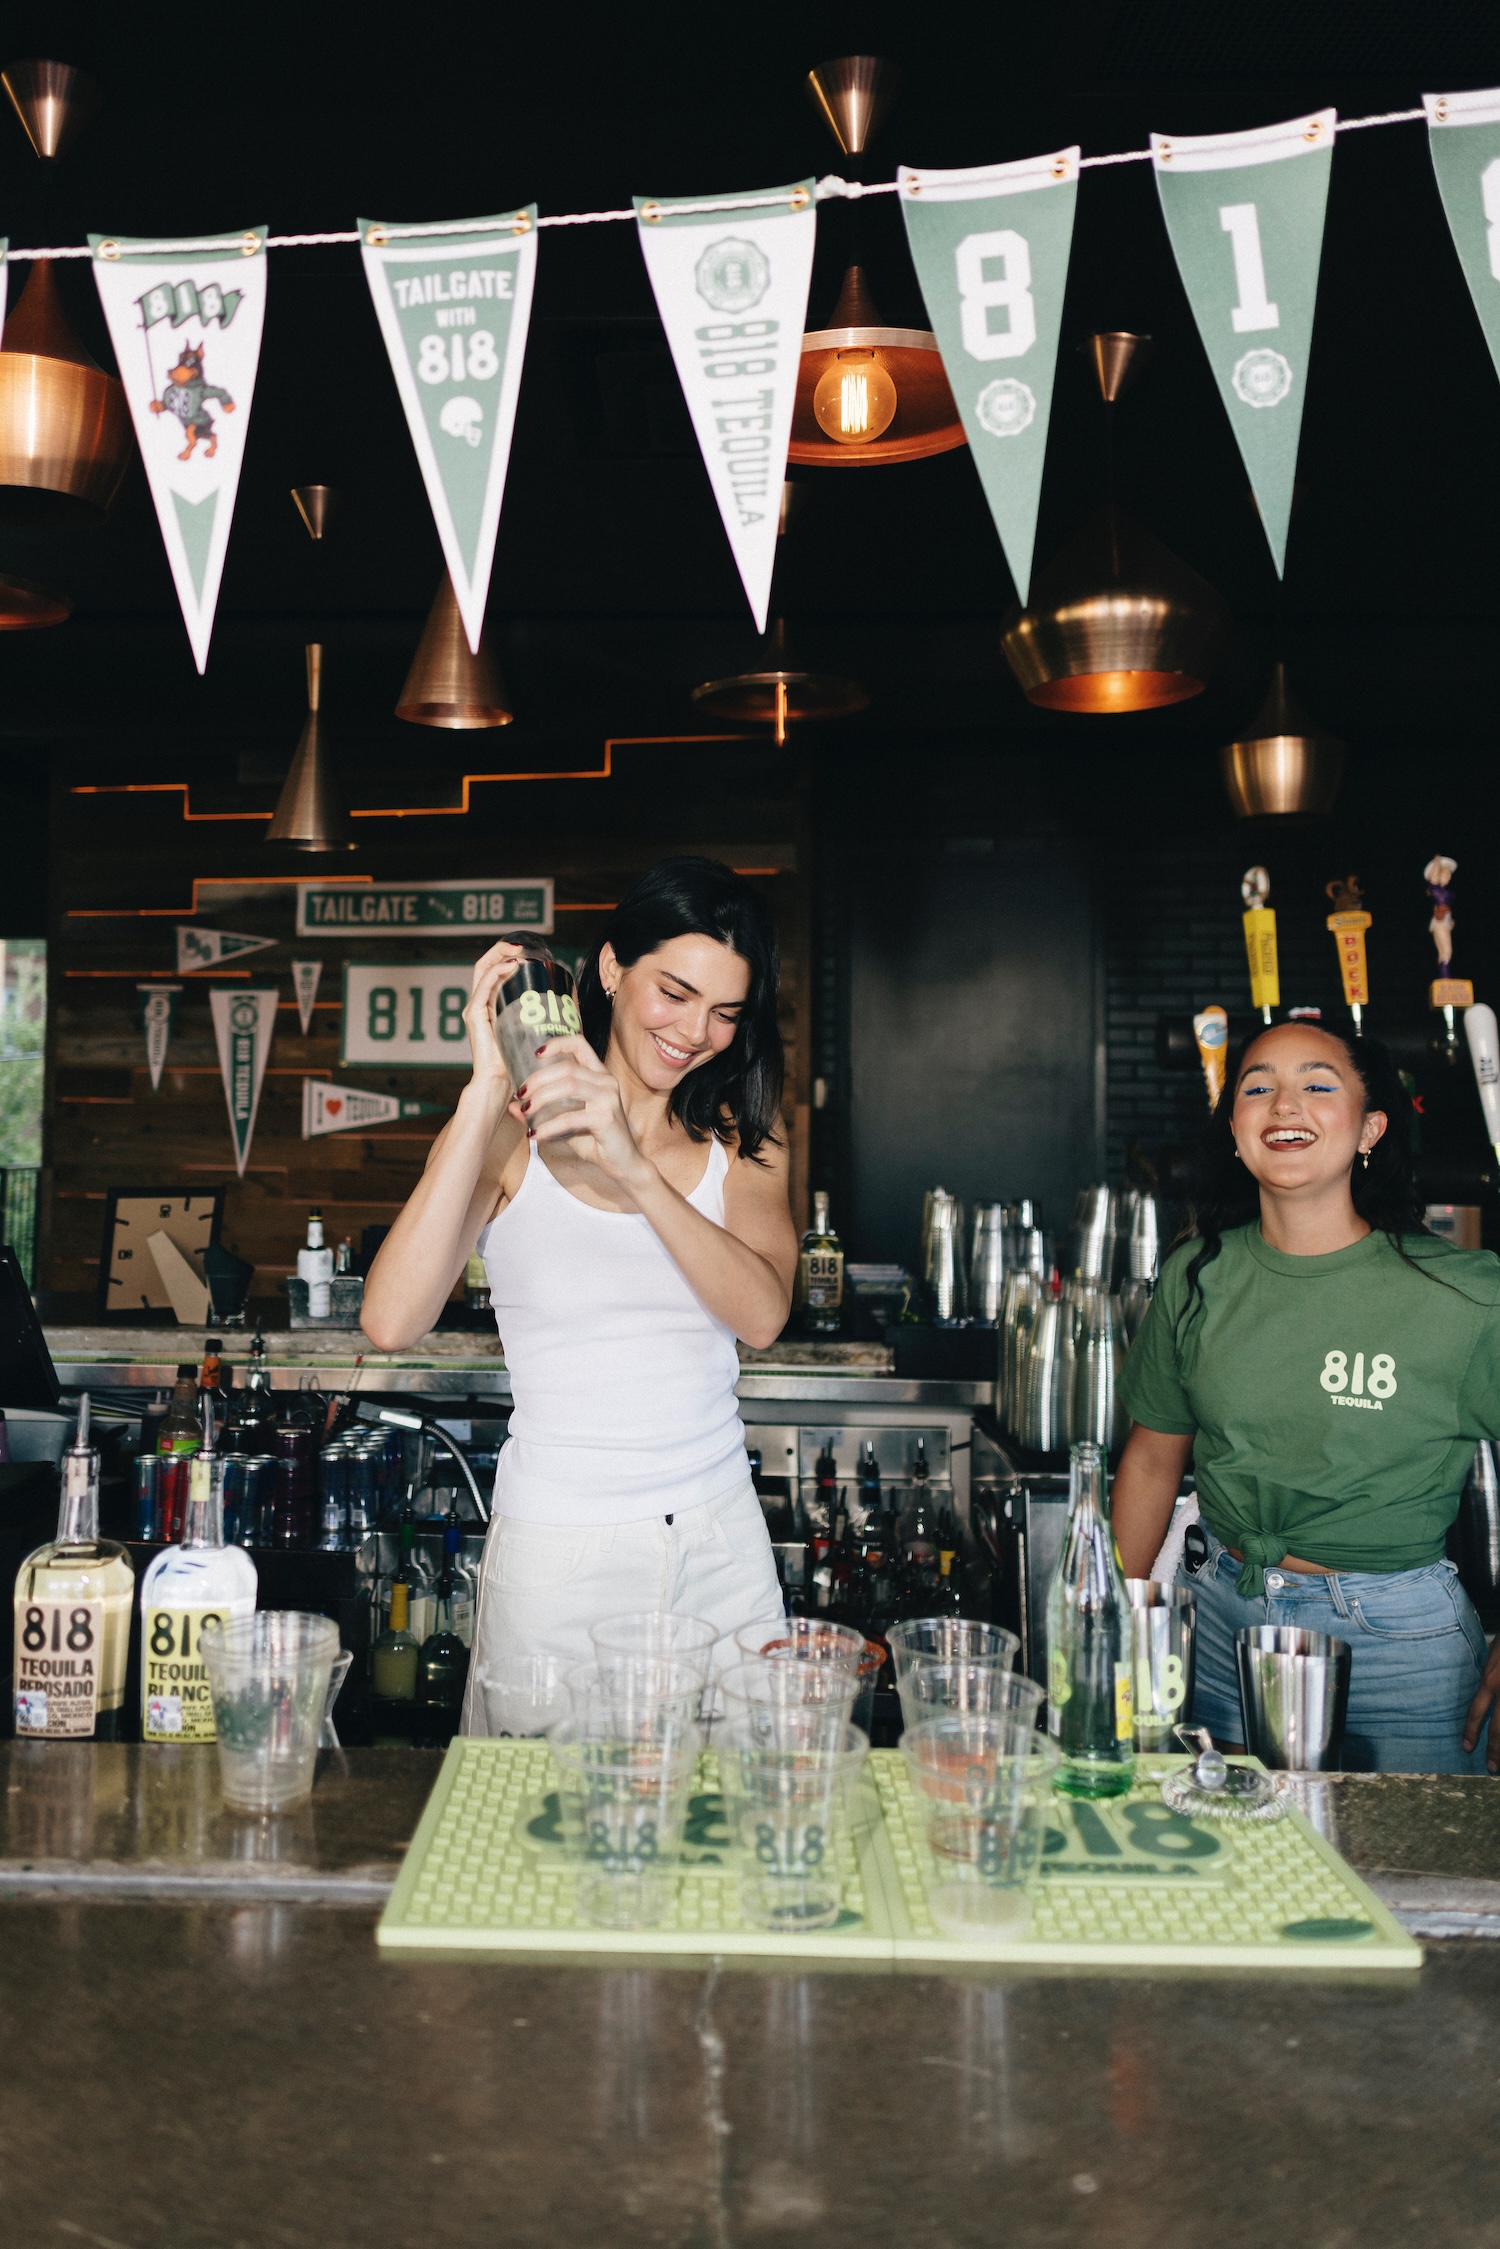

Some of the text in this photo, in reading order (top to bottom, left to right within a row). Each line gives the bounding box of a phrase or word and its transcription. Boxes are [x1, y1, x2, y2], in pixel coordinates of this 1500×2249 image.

[1218, 203, 1280, 333] 1
[148, 282, 223, 320] 818
[394, 269, 513, 309] TAILGATE
[955, 229, 1037, 362] 8
[435, 306, 477, 328] WITH
[417, 329, 500, 385] 818
[694, 319, 780, 528] 818 TEQUILA
[312, 895, 418, 923] TAILGATE
[462, 894, 505, 921] 818
[368, 986, 467, 1042] 818
[519, 989, 581, 1031] 818
[346, 1094, 391, 1122] TEQUILA
[809, 1258, 838, 1275] 818
[1319, 1349, 1398, 1399] 818
[1330, 1394, 1384, 1411] TEQUILA
[22, 1606, 94, 1653] 818
[19, 1657, 94, 1678] TEQUILA
[149, 1662, 209, 1682] TEQUIL
[1136, 1654, 1186, 1712] 18
[148, 1683, 210, 1702] BLANC
[1132, 1713, 1175, 1727] QUILA
[755, 1824, 824, 1866] 818
